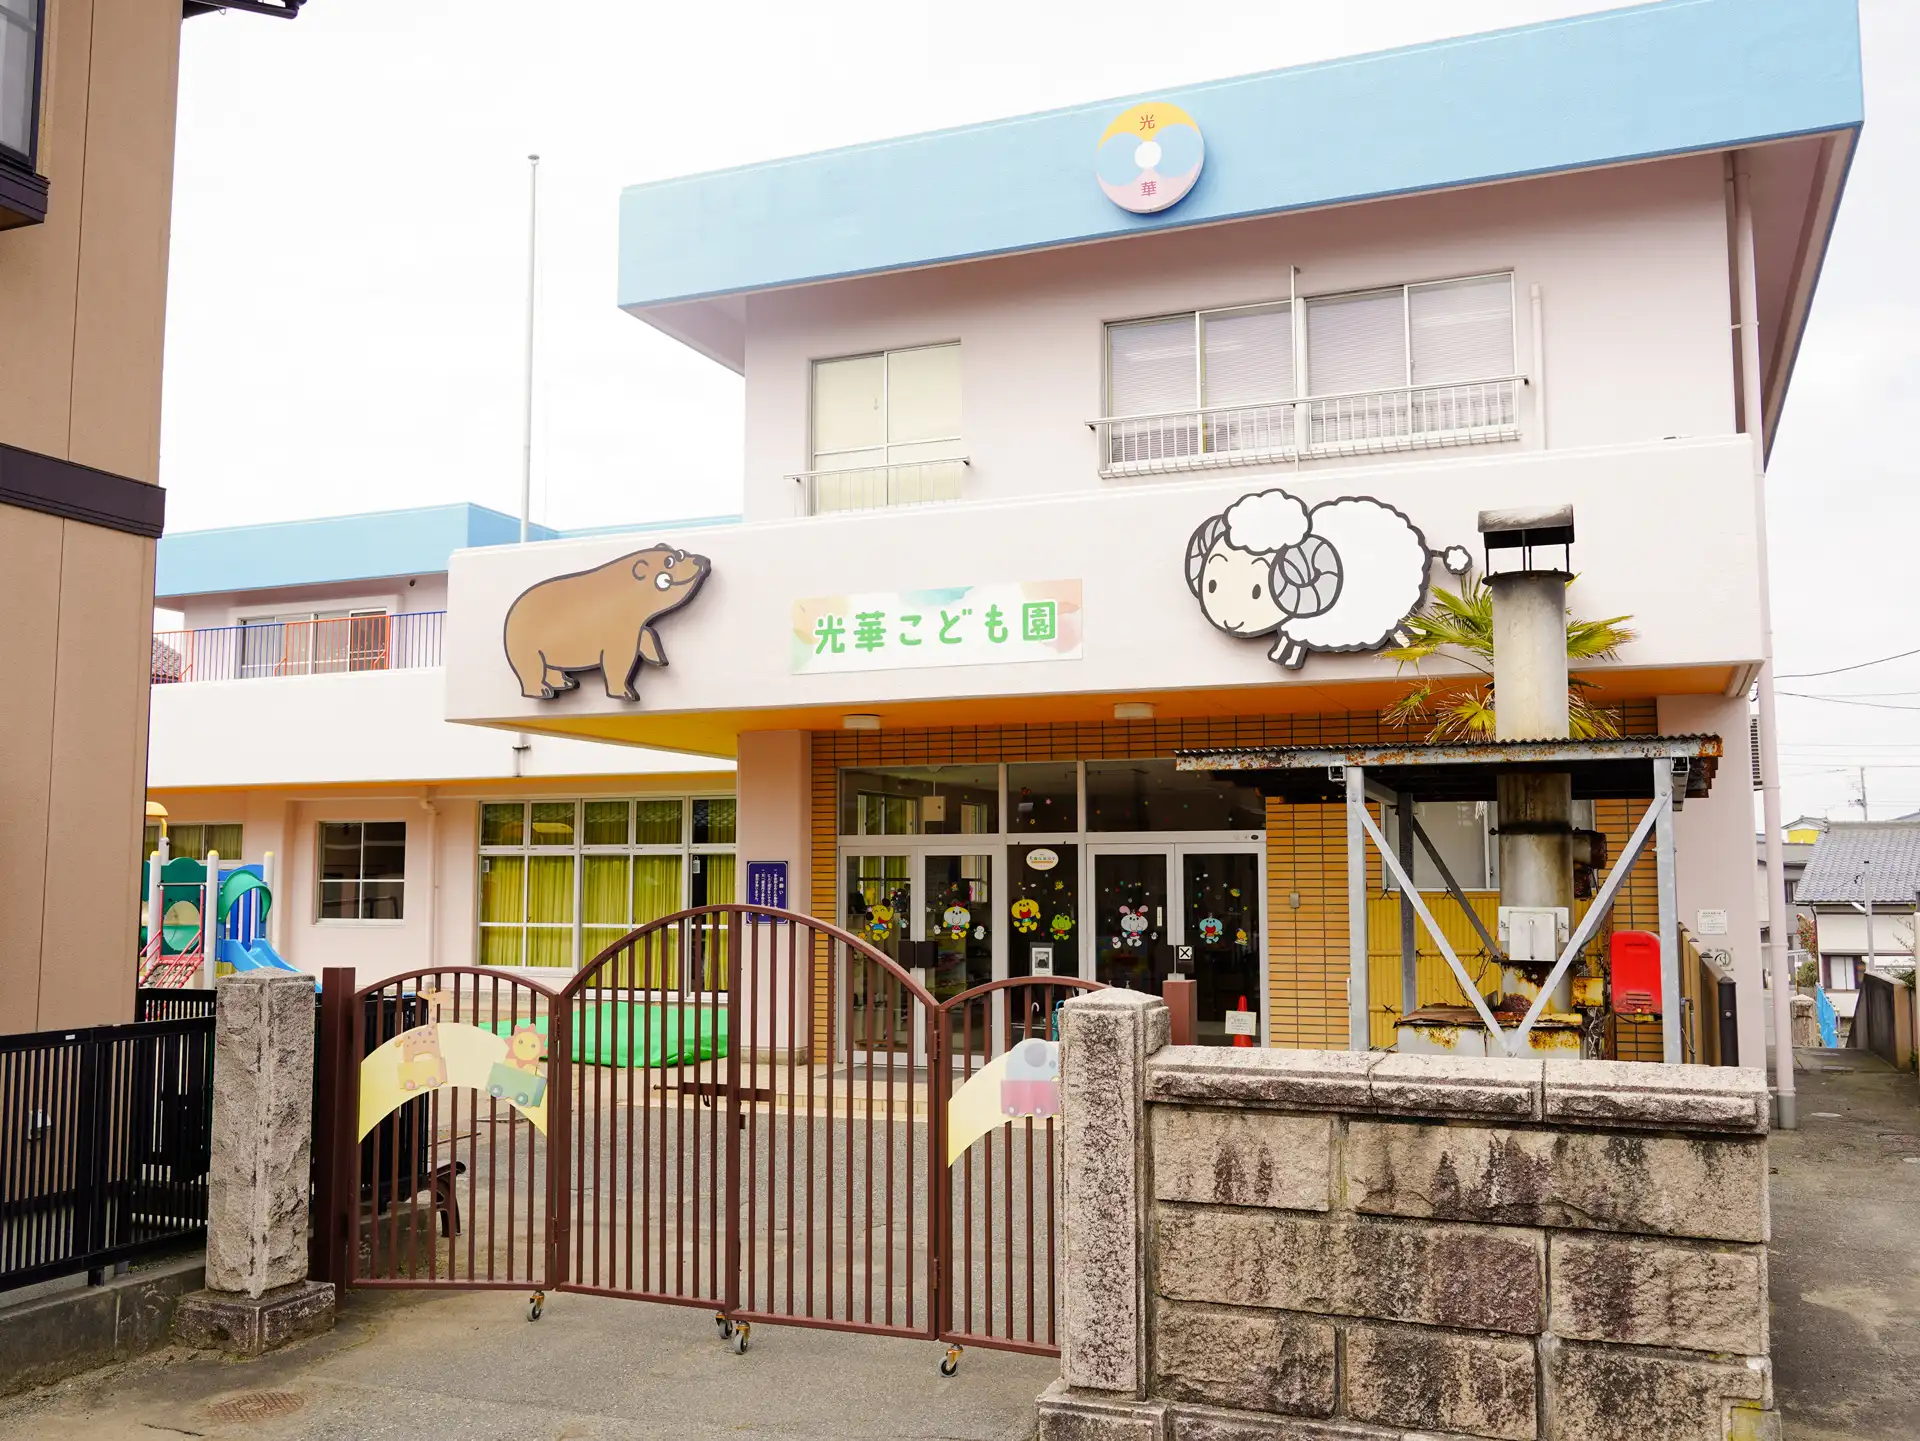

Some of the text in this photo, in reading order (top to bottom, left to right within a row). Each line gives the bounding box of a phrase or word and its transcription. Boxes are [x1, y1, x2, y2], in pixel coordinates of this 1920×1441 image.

[1140, 114, 1155, 131] 光
[1141, 181, 1156, 196] 華
[815, 601, 1055, 654] 光華こども園
